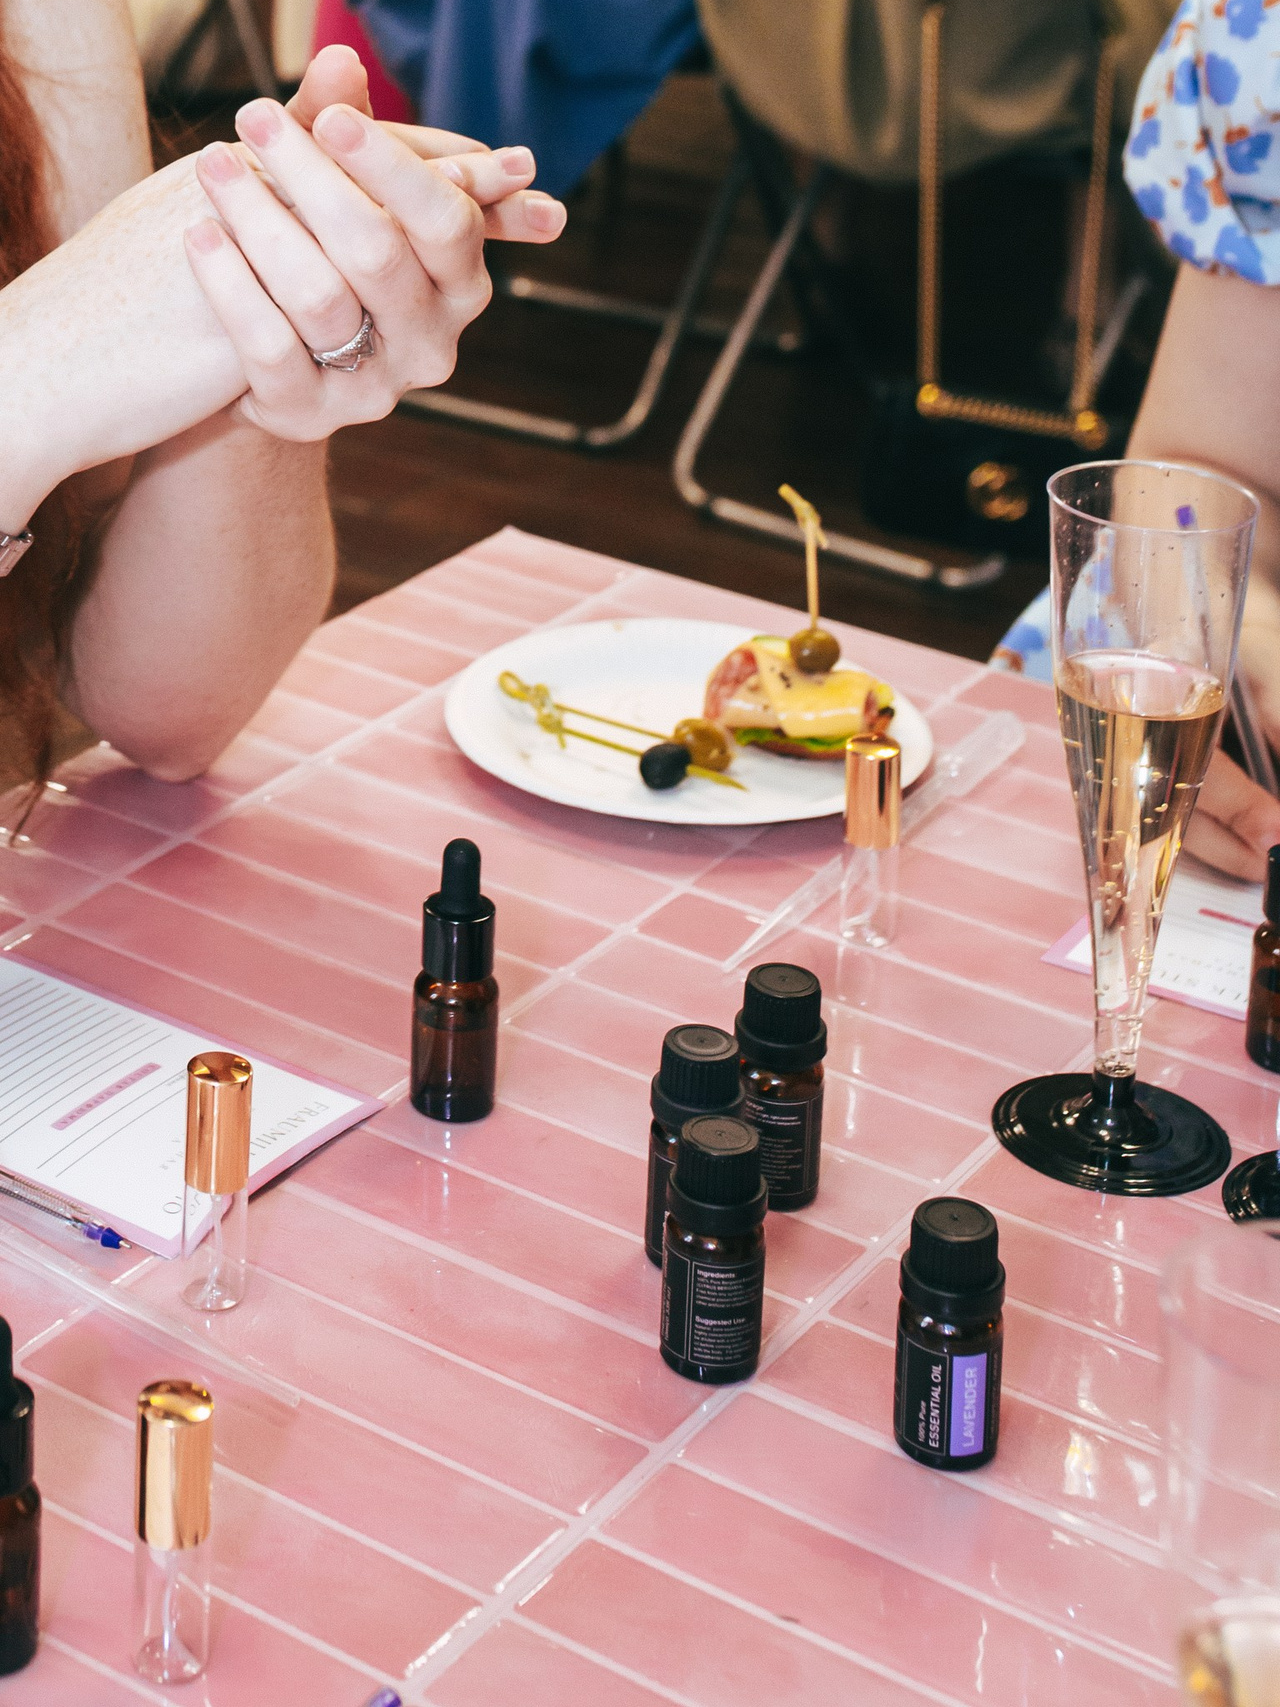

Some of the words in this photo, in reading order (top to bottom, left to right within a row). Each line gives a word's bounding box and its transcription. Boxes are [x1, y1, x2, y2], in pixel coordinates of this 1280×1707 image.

[930, 1363, 942, 1383] OIL
[928, 1385, 941, 1449] ESSENTIAL
[961, 1366, 978, 1449] LAVENDER
